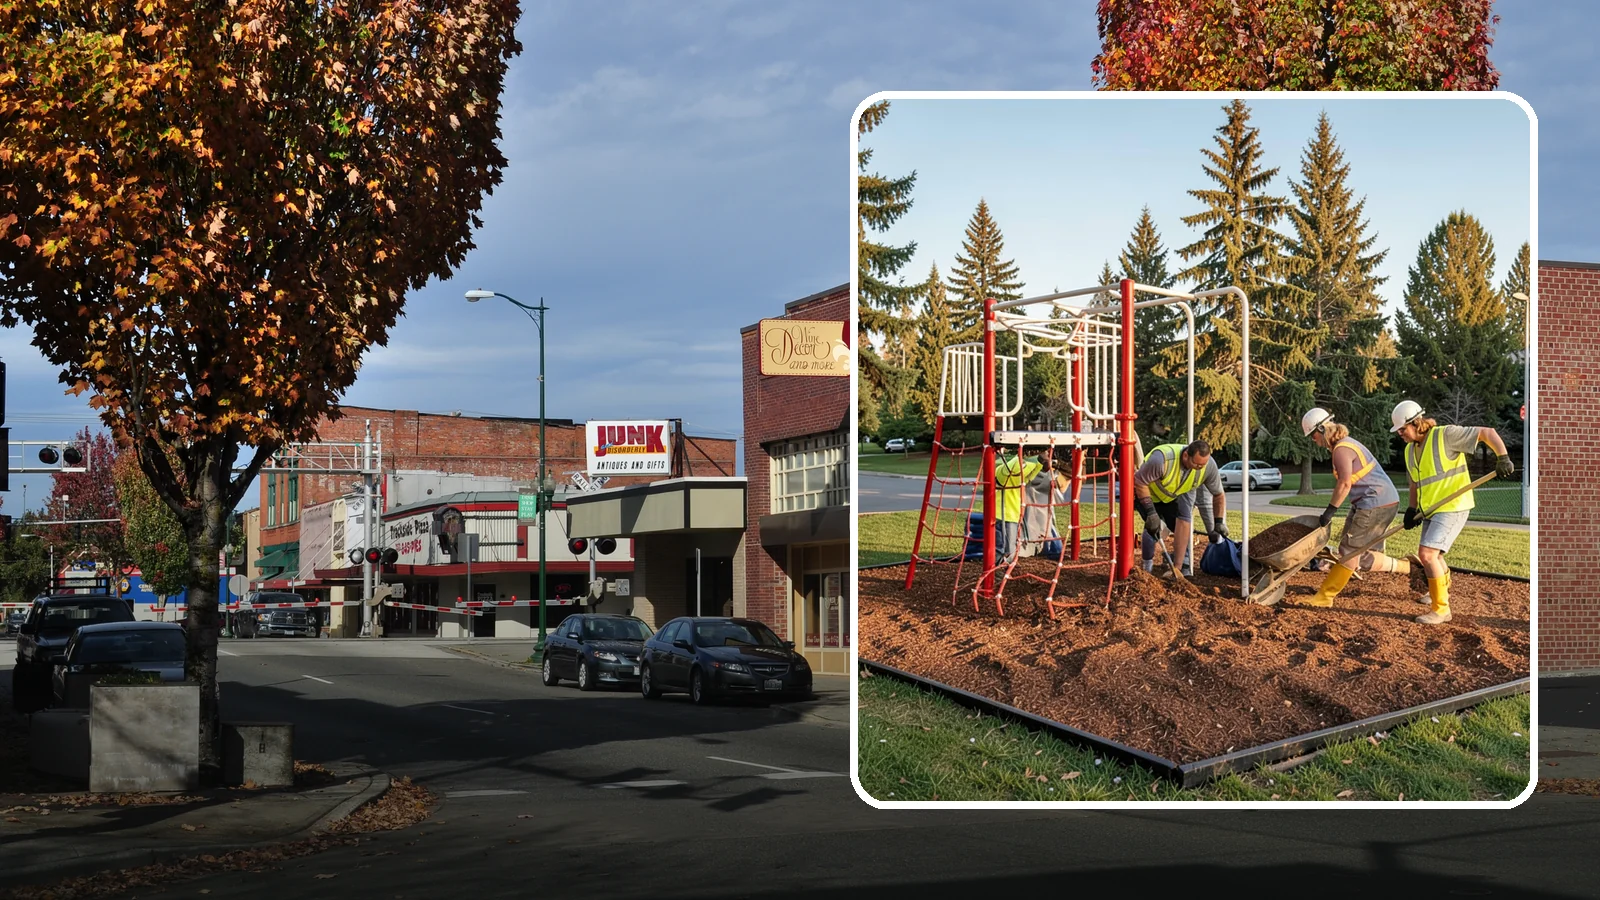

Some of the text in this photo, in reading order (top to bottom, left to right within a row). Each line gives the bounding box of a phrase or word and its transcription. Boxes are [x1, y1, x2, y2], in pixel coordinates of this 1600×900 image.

[595, 425, 665, 457] JUNK
[607, 446, 646, 454] DISORDERLY
[597, 460, 665, 470] ANTIQUES AND GIFTS
[573, 473, 588, 492] RAIL
[590, 476, 608, 492] SING
[415, 519, 429, 535] Pizza
